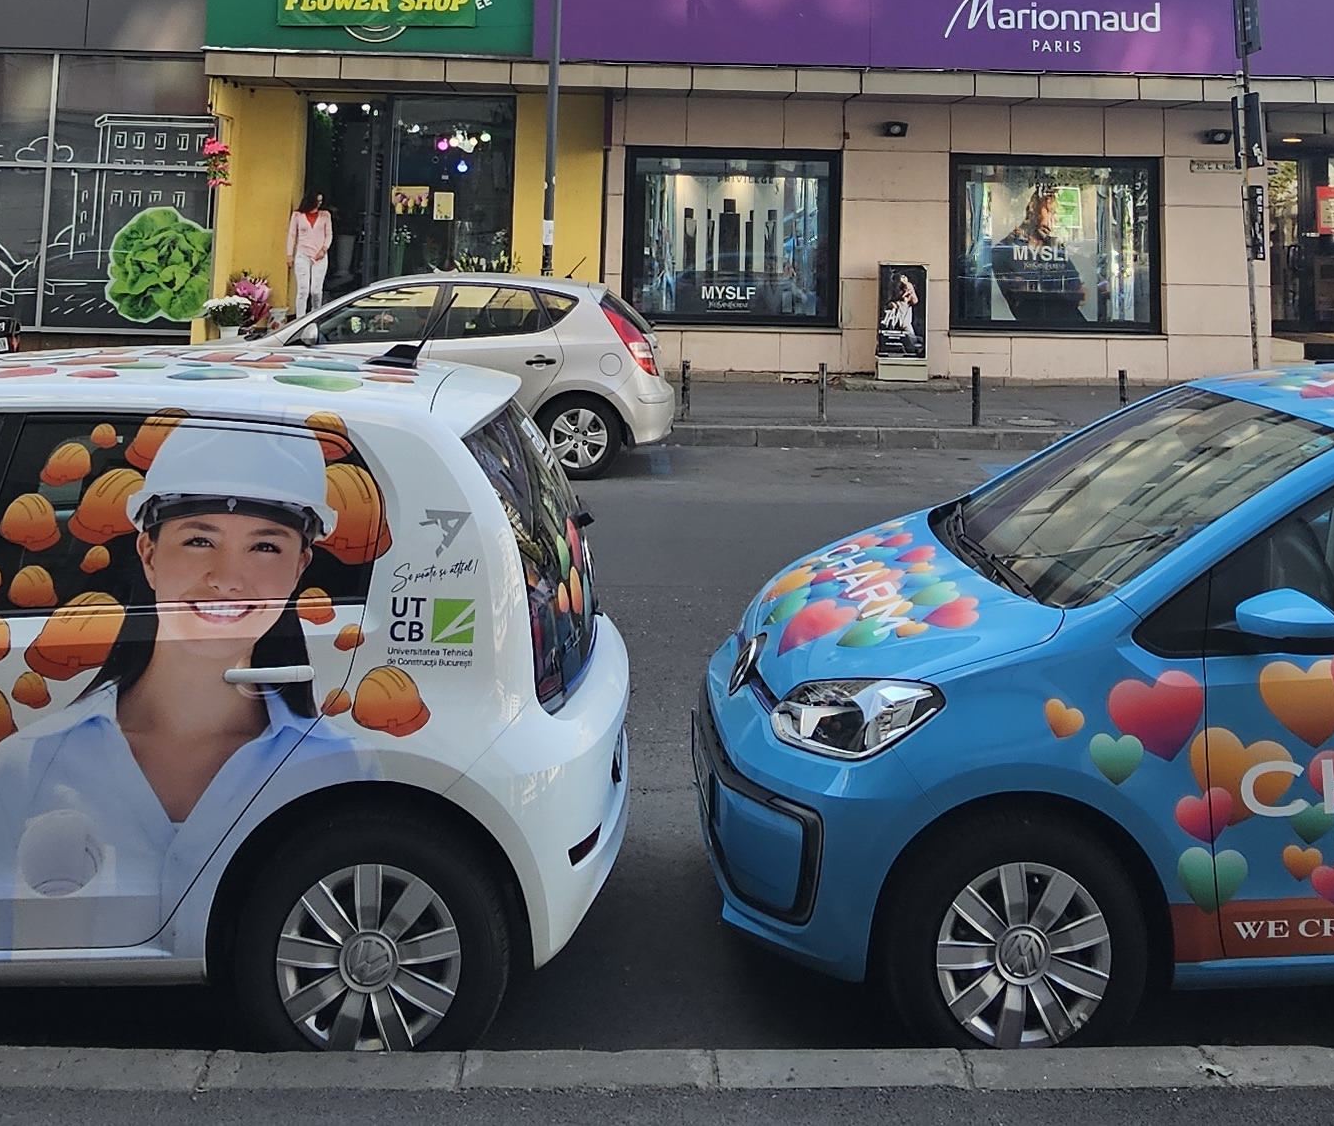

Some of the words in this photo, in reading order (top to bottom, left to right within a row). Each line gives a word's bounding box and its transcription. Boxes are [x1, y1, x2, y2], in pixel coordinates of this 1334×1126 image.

[1032, 40, 1082, 53] PARIS
[701, 285, 756, 300] MYSLF
[819, 544, 910, 637] CHARM
[391, 596, 427, 618] UT
[389, 620, 425, 642] CB
[387, 647, 440, 656] Universitatea
[387, 657, 396, 665] de
[1234, 919, 1289, 940] WE
